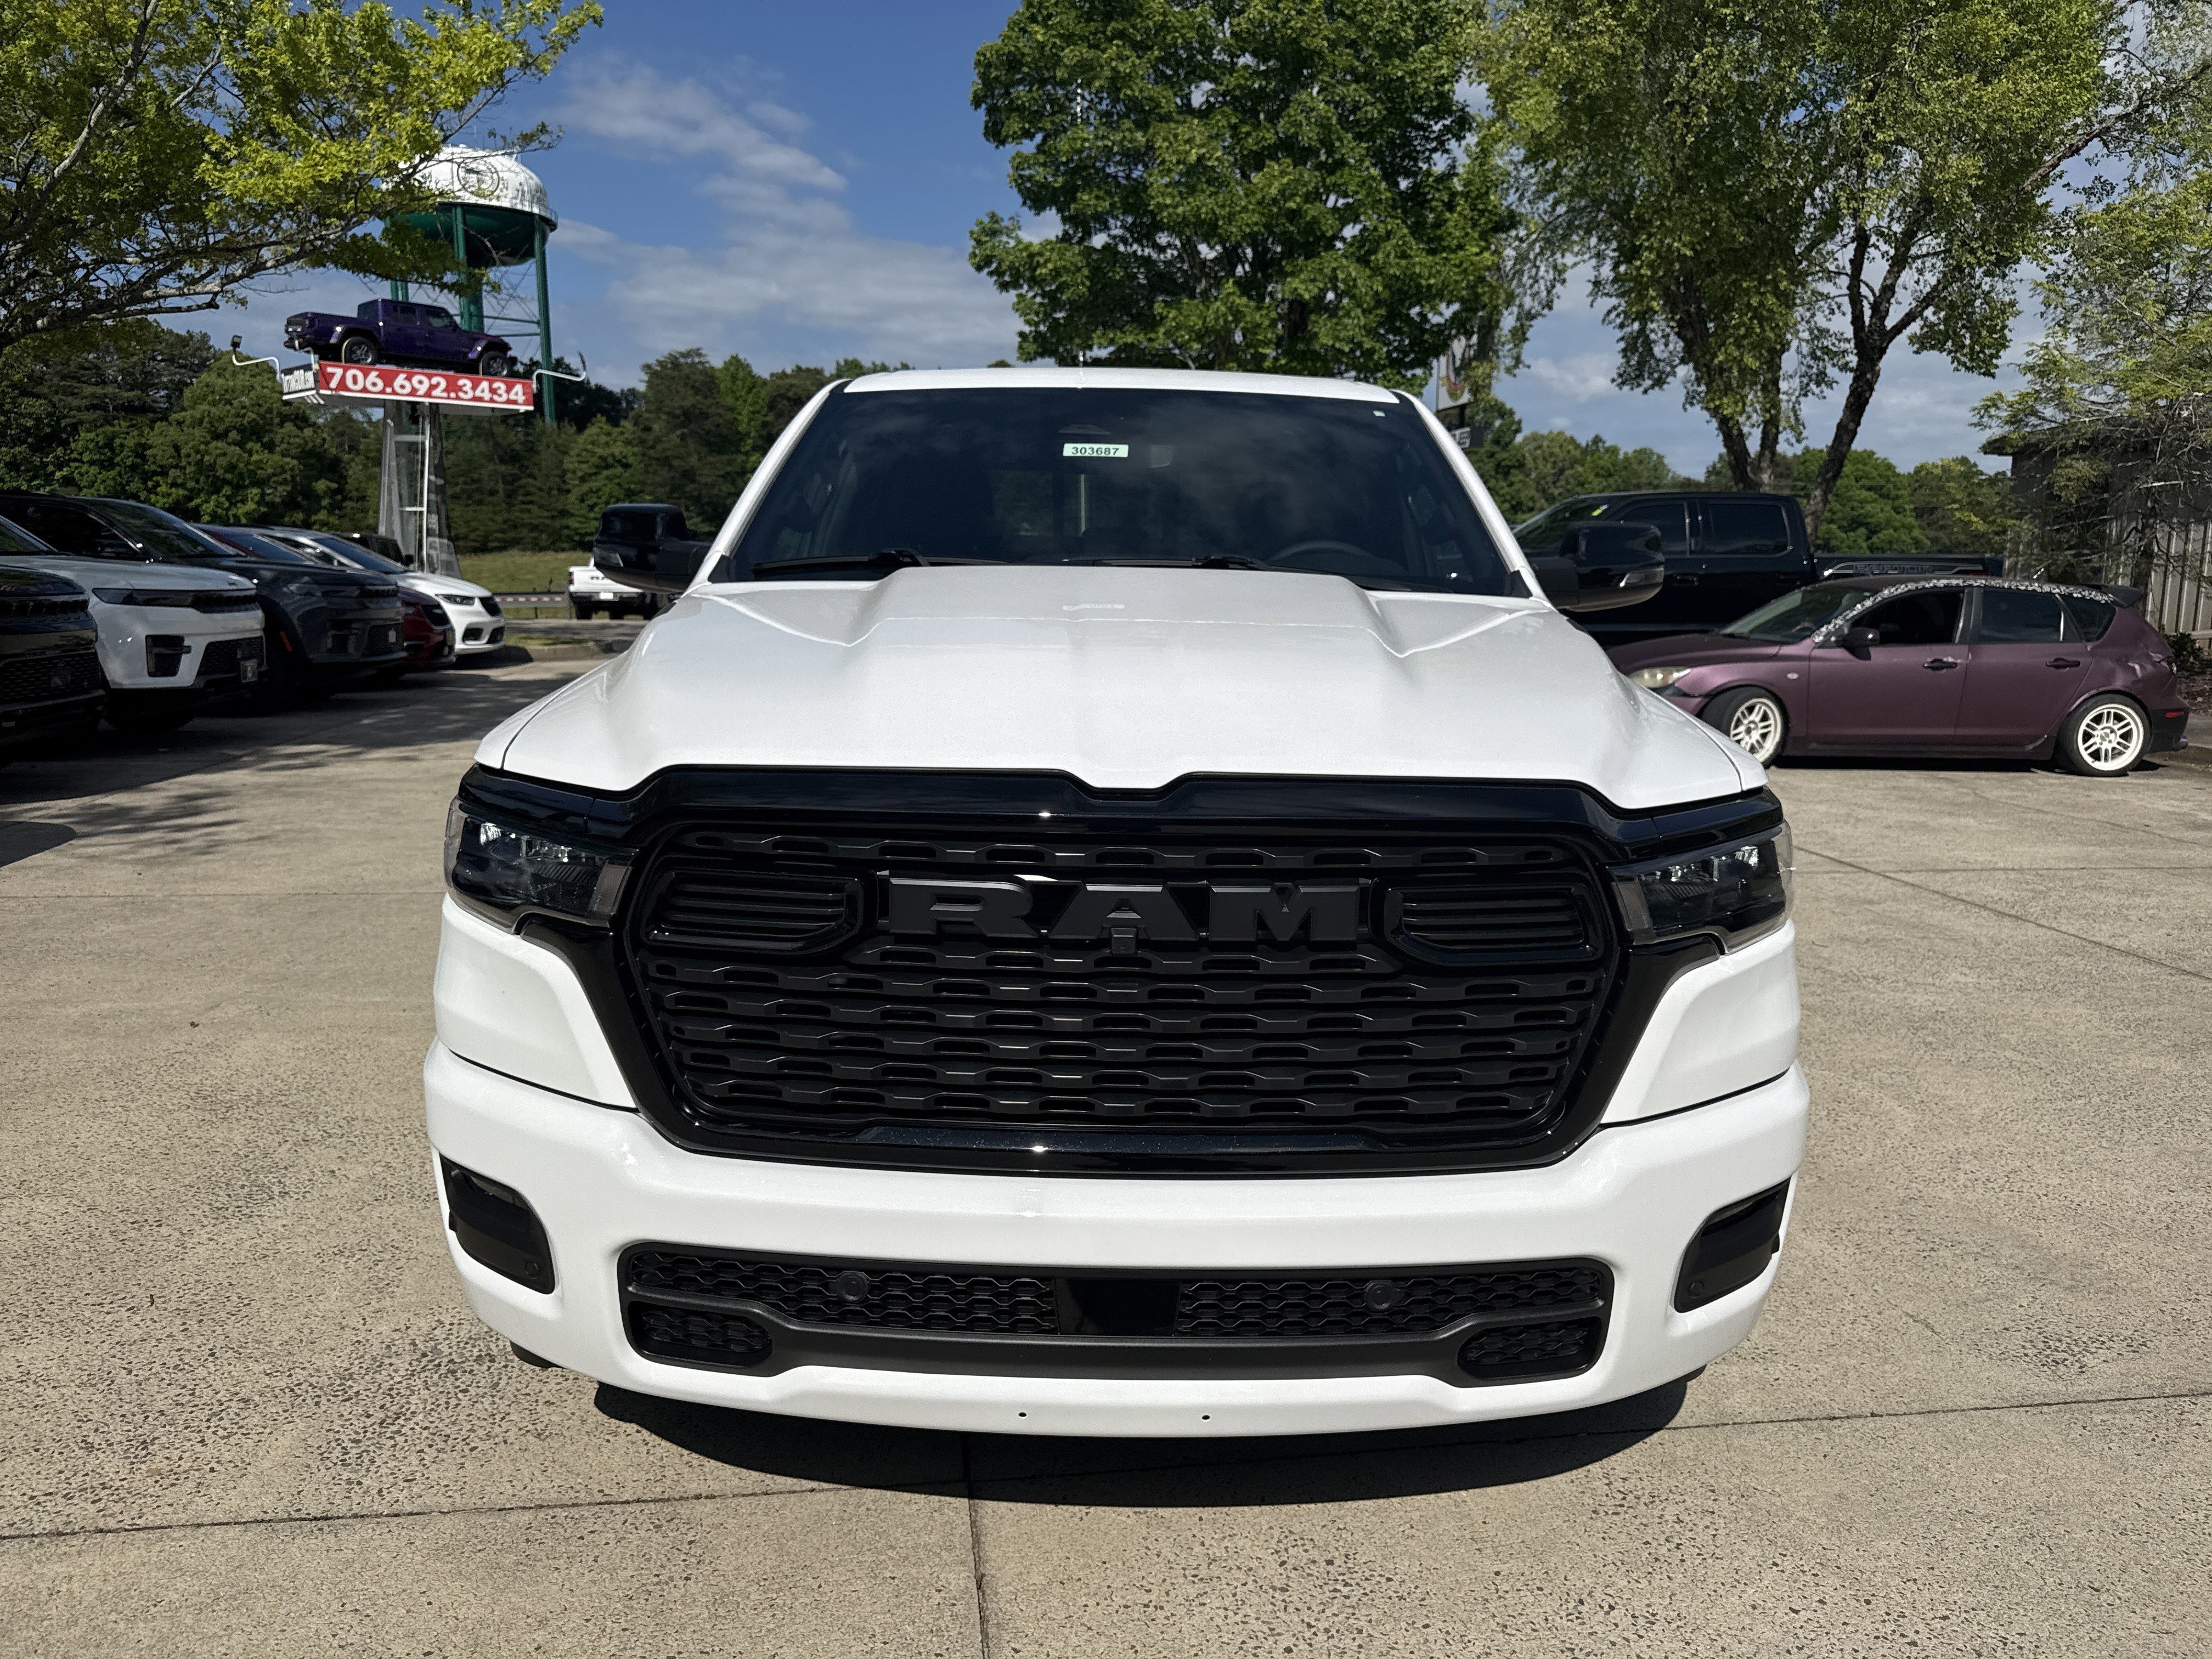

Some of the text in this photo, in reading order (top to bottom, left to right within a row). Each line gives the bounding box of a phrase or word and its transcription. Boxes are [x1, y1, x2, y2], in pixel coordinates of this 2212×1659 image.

[326, 366, 526, 404] 706.692.3434
[1071, 447, 1119, 455] 303687
[889, 878, 1359, 942] RAM
